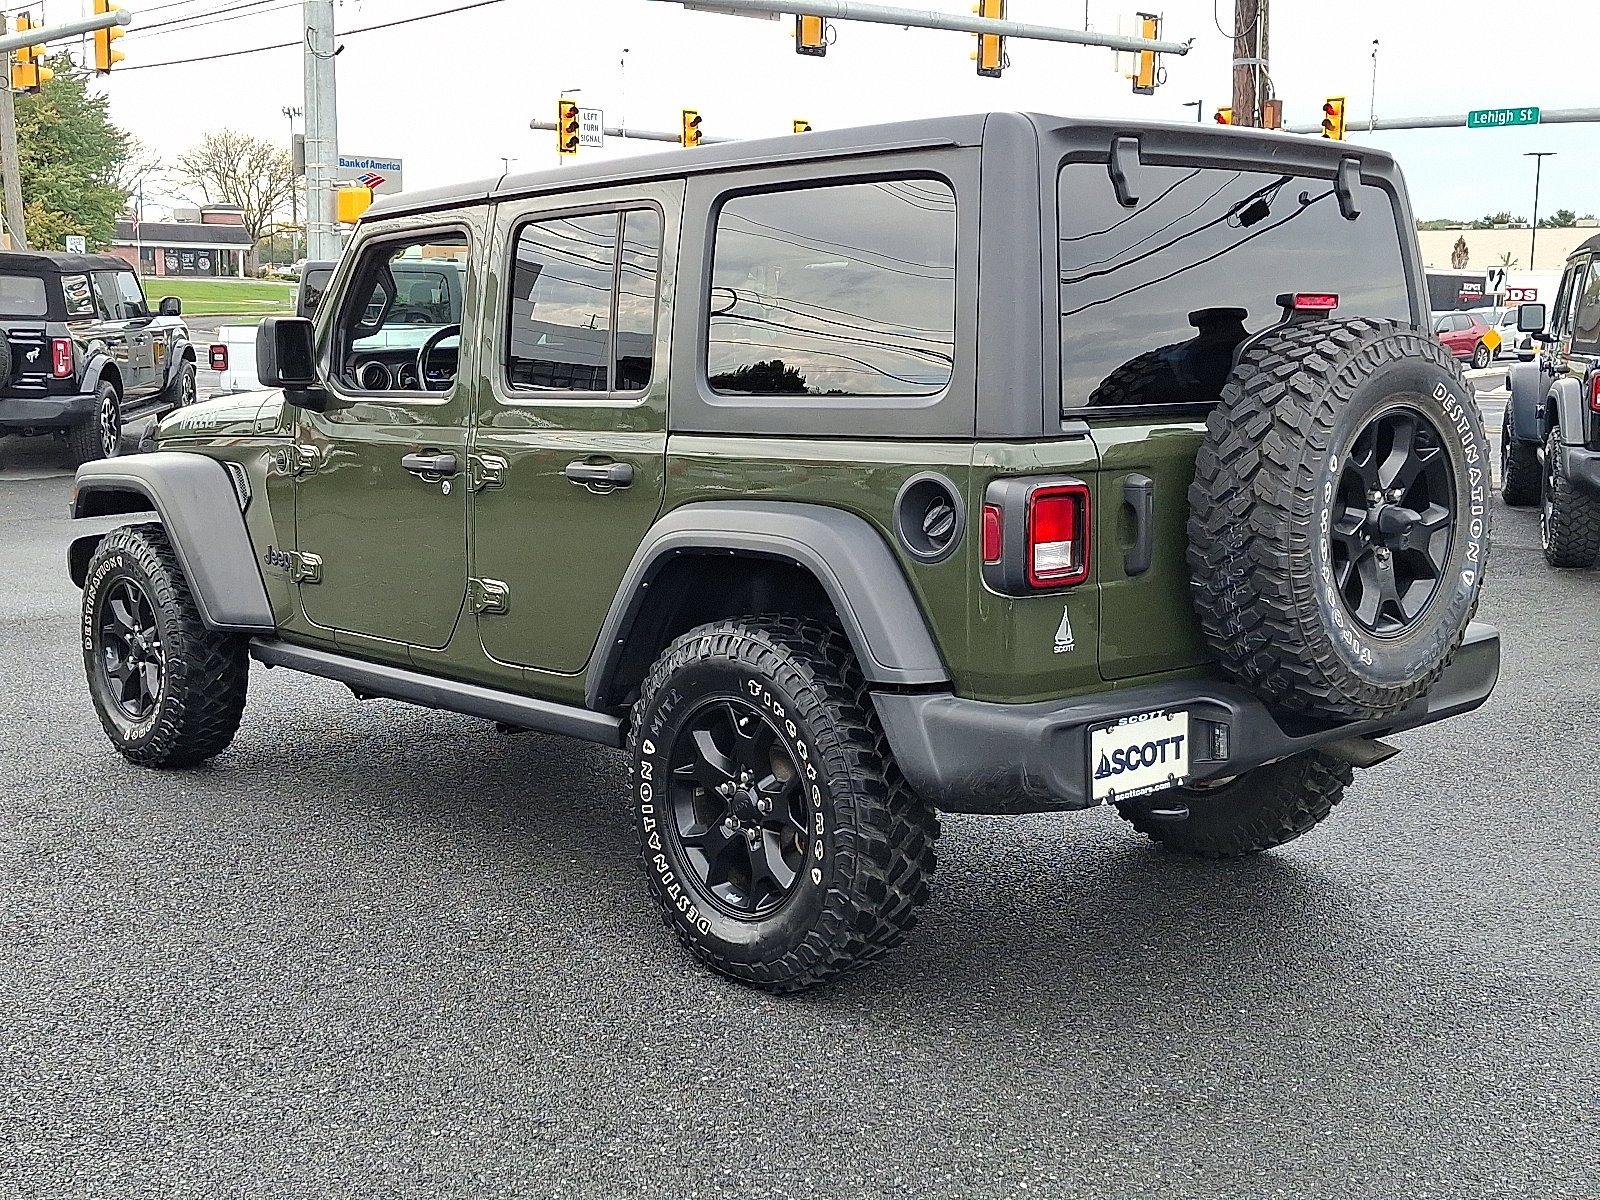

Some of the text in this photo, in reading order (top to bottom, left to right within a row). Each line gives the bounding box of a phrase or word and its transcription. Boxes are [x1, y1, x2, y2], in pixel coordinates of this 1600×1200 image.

[583, 112, 598, 121] LEFT
[1473, 109, 1533, 125] Lehigh St
[583, 123, 599, 132] TURN
[580, 134, 602, 143] SIGNAL
[339, 158, 400, 170] Bank of America
[1431, 382, 1485, 564] DESTINATION
[264, 545, 291, 572] Jeep
[84, 557, 118, 650] DESTINATION
[1053, 643, 1076, 655] SCOTT
[1118, 709, 1166, 727] SCOTT
[1111, 734, 1185, 775] SCOTT
[1114, 781, 1171, 802] scottcars.com
[640, 760, 714, 937] DESTINATION
